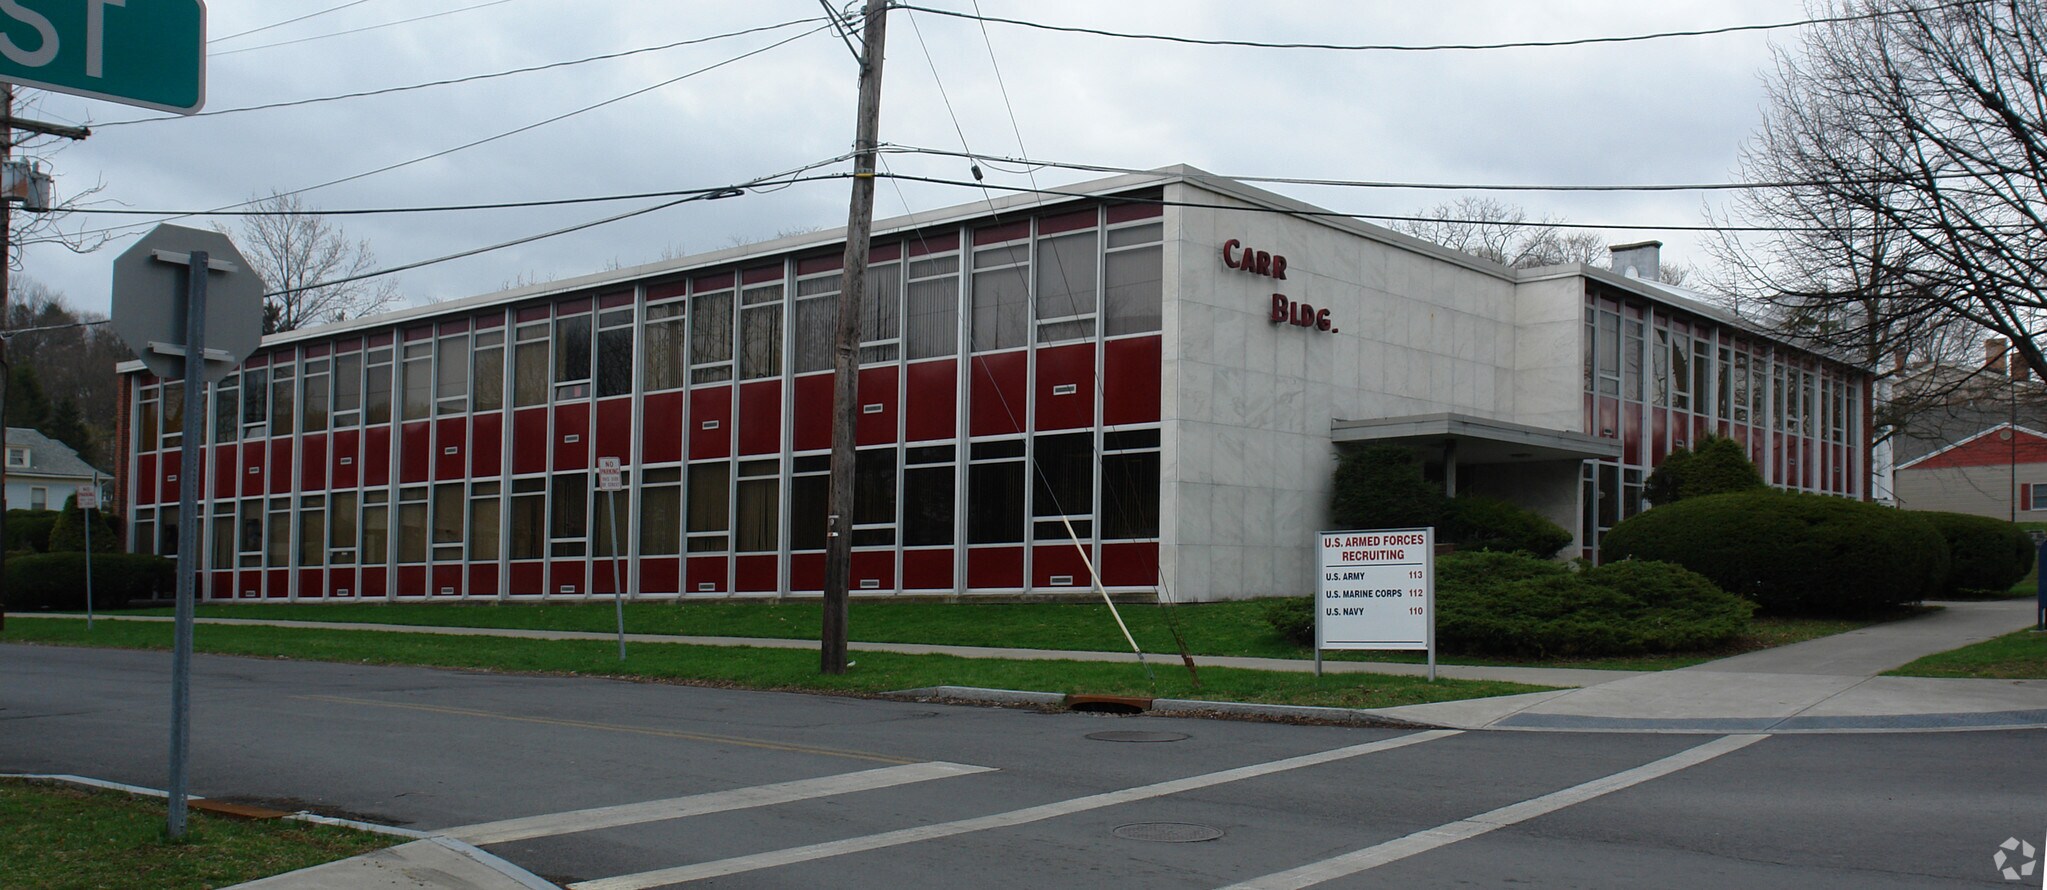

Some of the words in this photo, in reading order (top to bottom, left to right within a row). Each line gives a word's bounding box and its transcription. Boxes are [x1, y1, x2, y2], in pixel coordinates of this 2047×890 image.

[0, 0, 126, 78] ST
[1223, 238, 1287, 280] CARR
[1271, 293, 1339, 333] BLDG.
[1324, 537, 1344, 548] U.S.
[1345, 536, 1381, 547] ARMED
[1383, 534, 1424, 546] FORCES
[1342, 549, 1405, 561] RECRUITING
[1326, 572, 1341, 581] U.S.
[1343, 572, 1365, 581] ARMY
[1409, 570, 1423, 579] 113
[1326, 590, 1341, 599] U.S.
[1343, 589, 1373, 598] MARINE
[1375, 589, 1402, 598] CORPS
[1409, 588, 1423, 597] 112
[1326, 608, 1341, 616] U.S.
[1343, 607, 1364, 616] NAVY
[1409, 606, 1423, 615] 110
